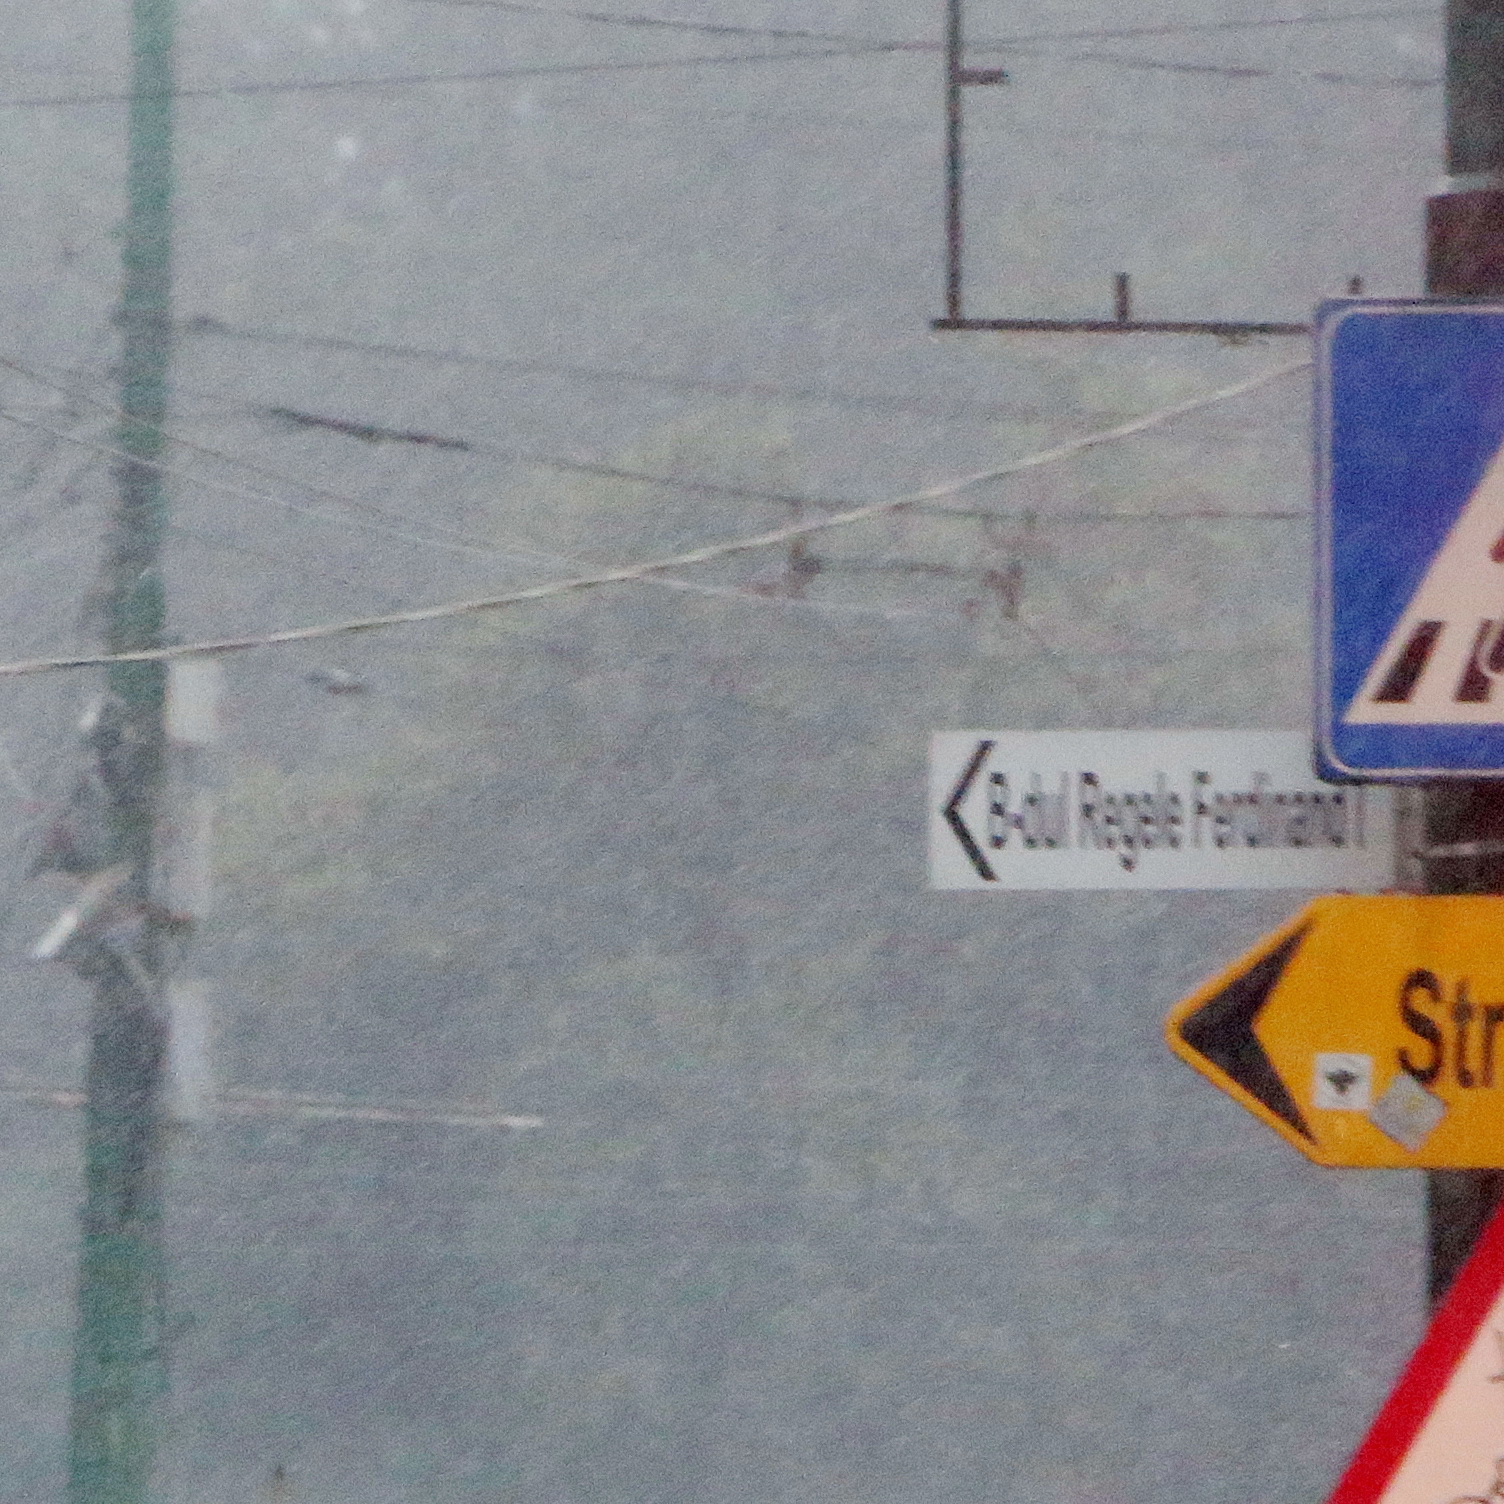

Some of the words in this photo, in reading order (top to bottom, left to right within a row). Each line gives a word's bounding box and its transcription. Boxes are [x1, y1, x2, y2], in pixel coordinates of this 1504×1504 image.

[989, 771, 1070, 848] B-dul
[1080, 770, 1183, 871] Regele
[1193, 770, 1348, 848] Ferdinand
